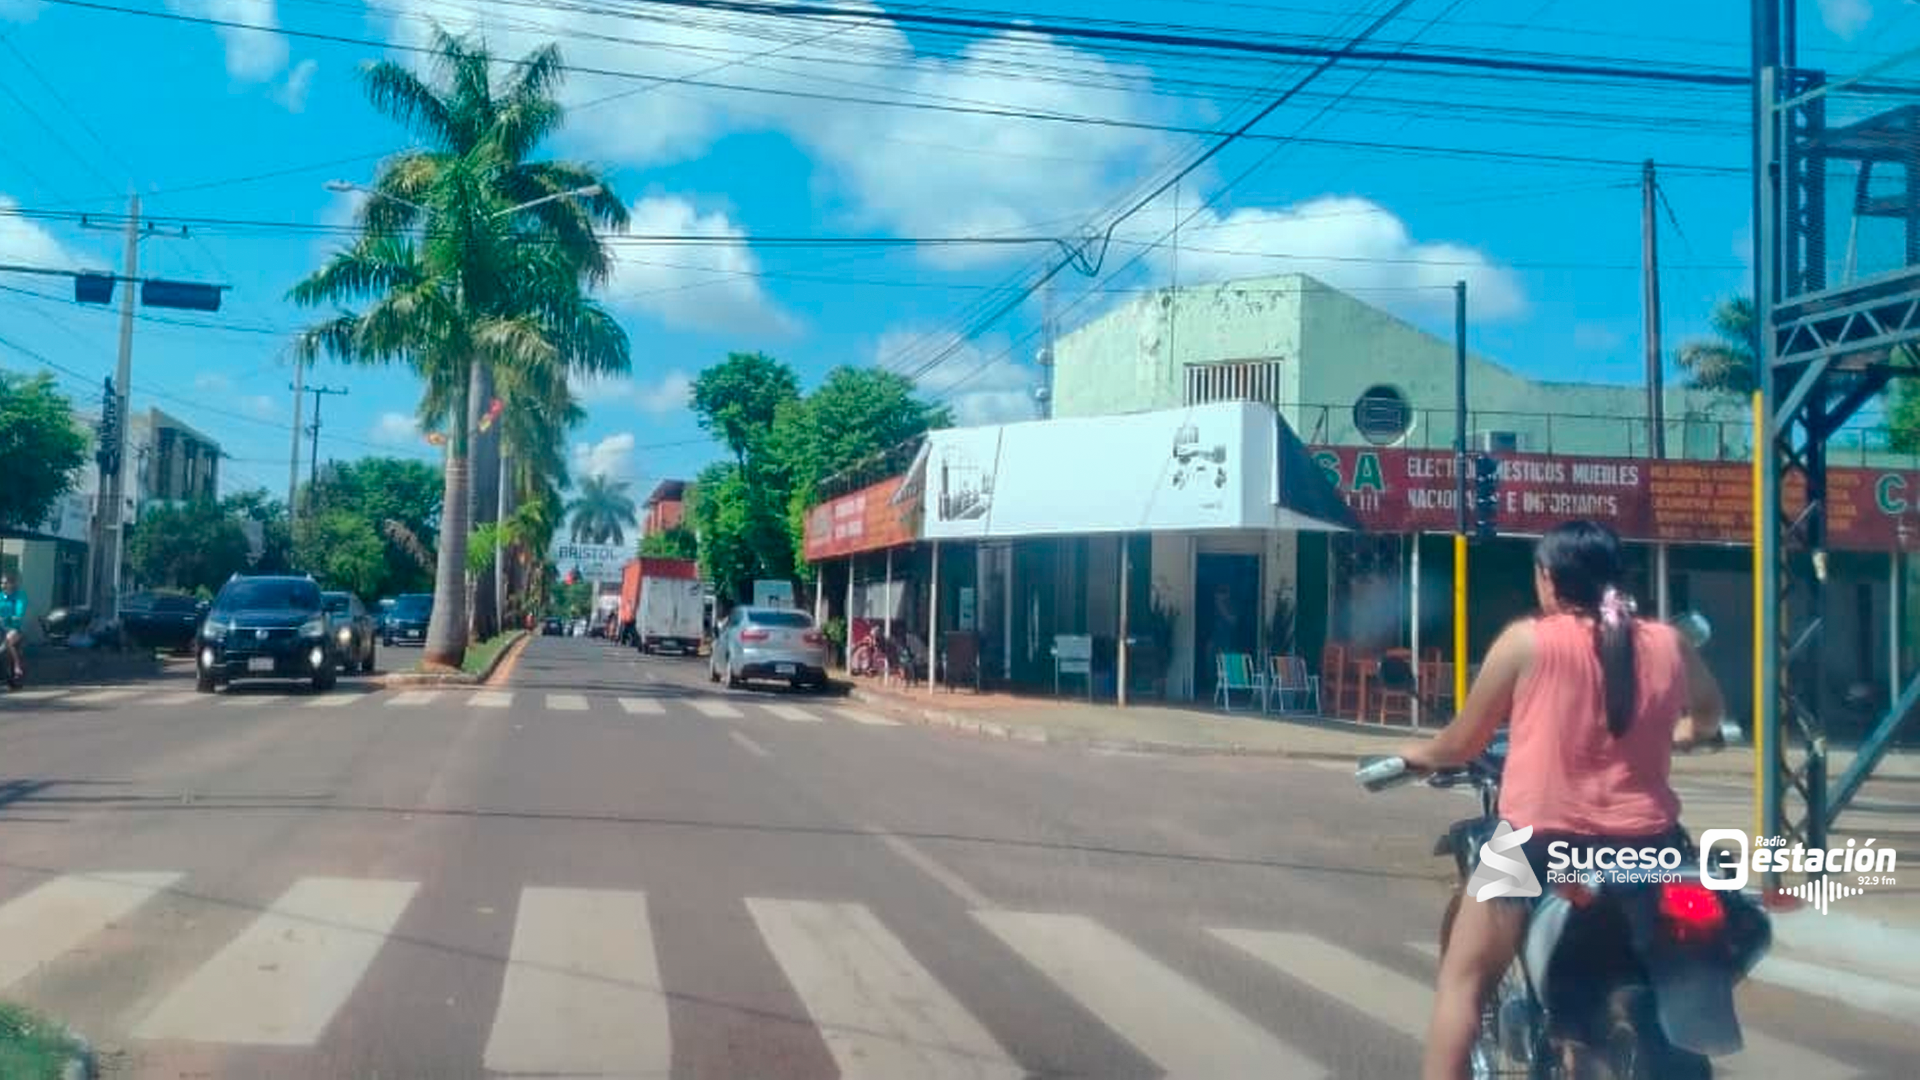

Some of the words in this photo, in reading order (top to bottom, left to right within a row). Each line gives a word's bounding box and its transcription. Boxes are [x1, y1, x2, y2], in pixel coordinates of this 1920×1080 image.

[1572, 463, 1639, 486] MUEBLES
[1507, 491, 1517, 513] E
[1875, 473, 1920, 515] C
